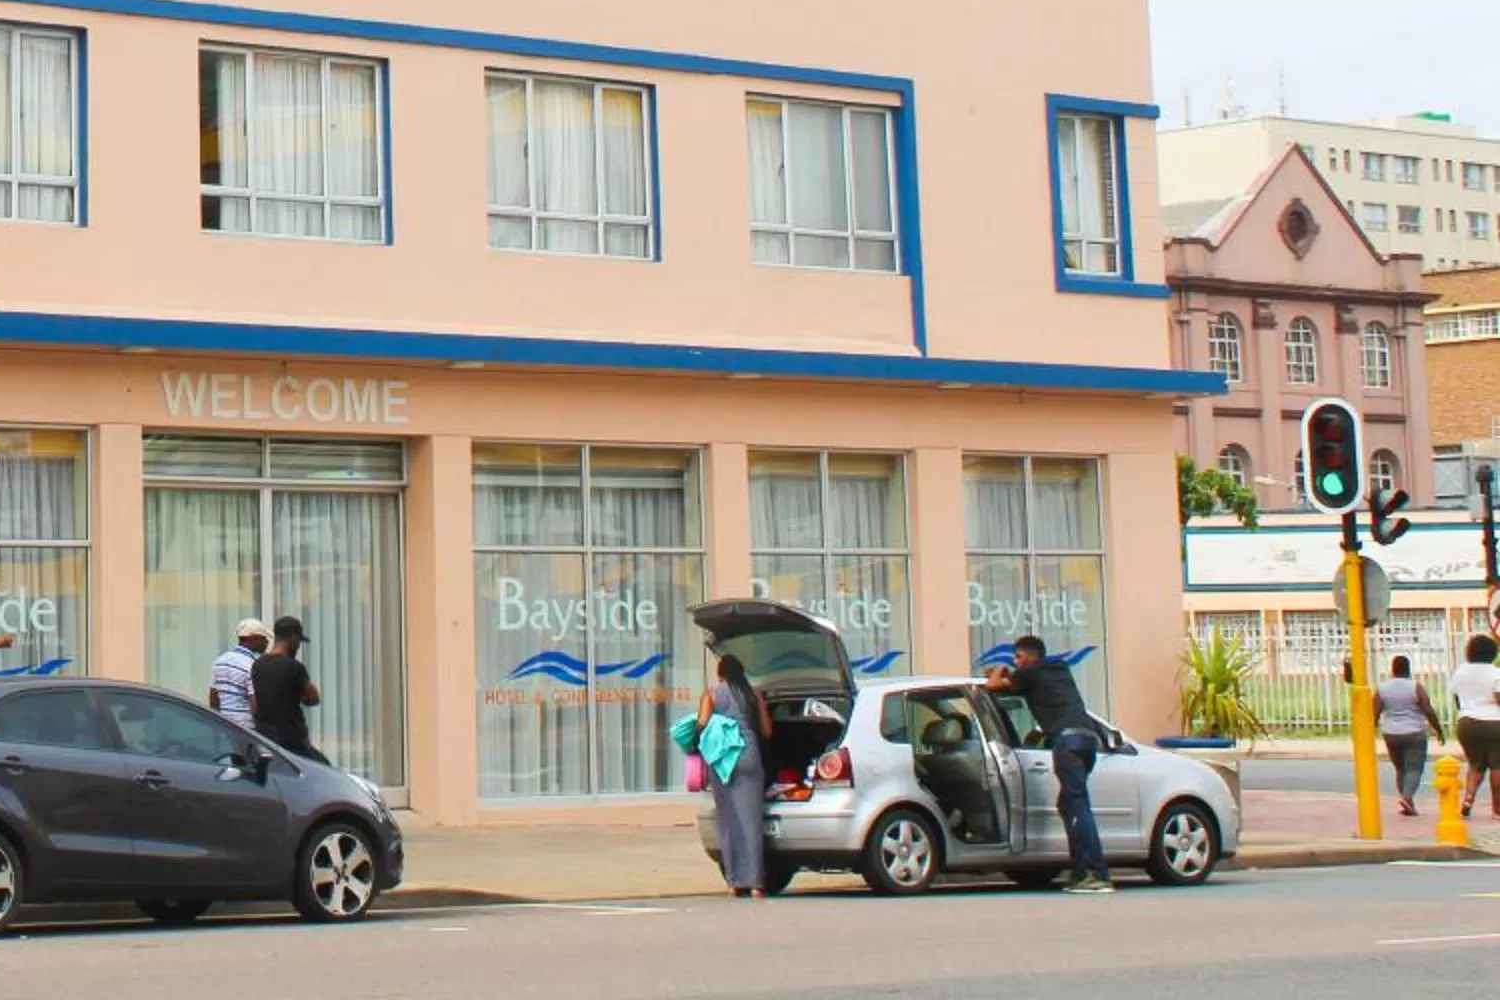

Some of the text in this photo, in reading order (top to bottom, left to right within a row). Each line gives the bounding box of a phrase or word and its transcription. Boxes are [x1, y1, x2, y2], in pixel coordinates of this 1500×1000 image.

[161, 371, 410, 424] WELCOME
[497, 576, 658, 640] Bayside
[964, 581, 1088, 634] Bayside
